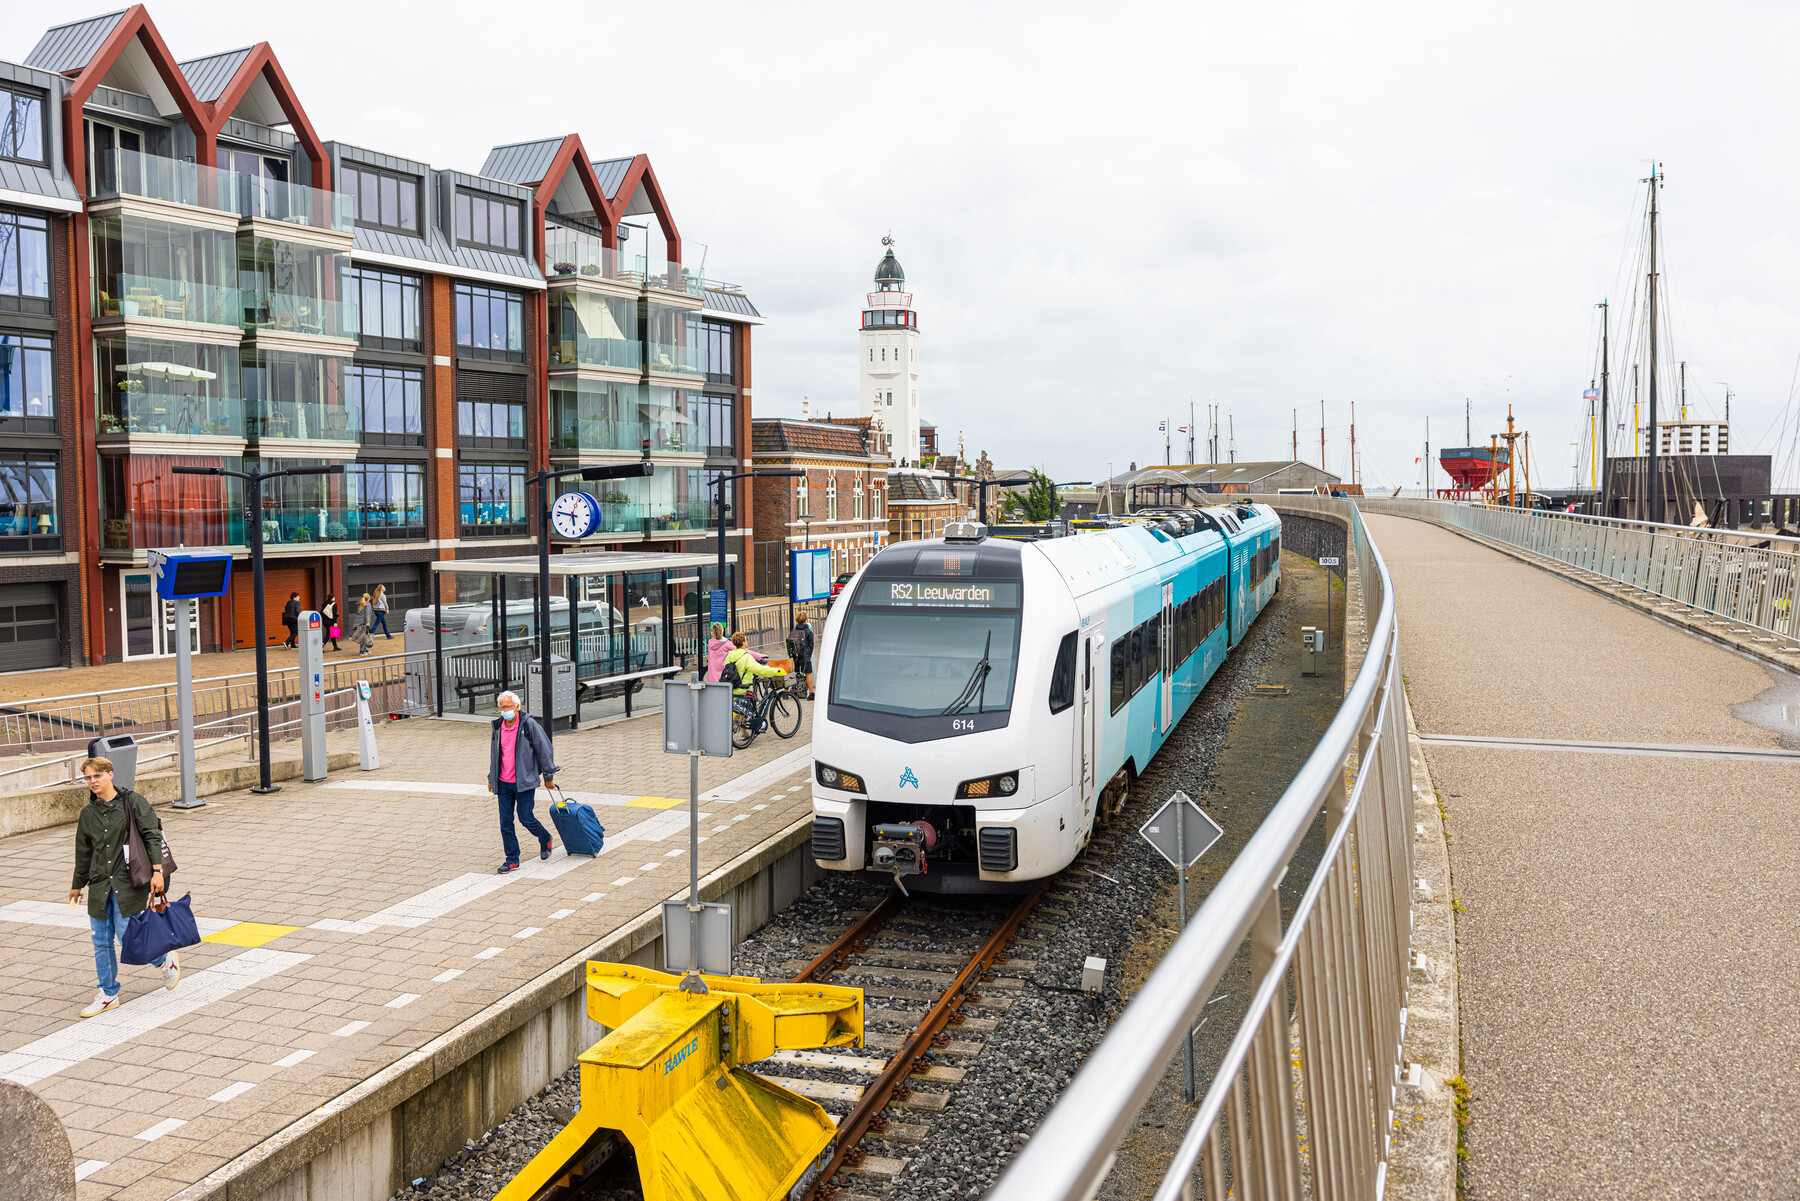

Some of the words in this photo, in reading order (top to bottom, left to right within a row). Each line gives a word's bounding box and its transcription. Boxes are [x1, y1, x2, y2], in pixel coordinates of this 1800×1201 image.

[1616, 460, 1675, 473] BADHUS
[891, 583, 913, 600] RS2
[917, 583, 990, 601] Leeuwarden
[952, 719, 975, 730] 614
[664, 1036, 699, 1076] RAWIE
